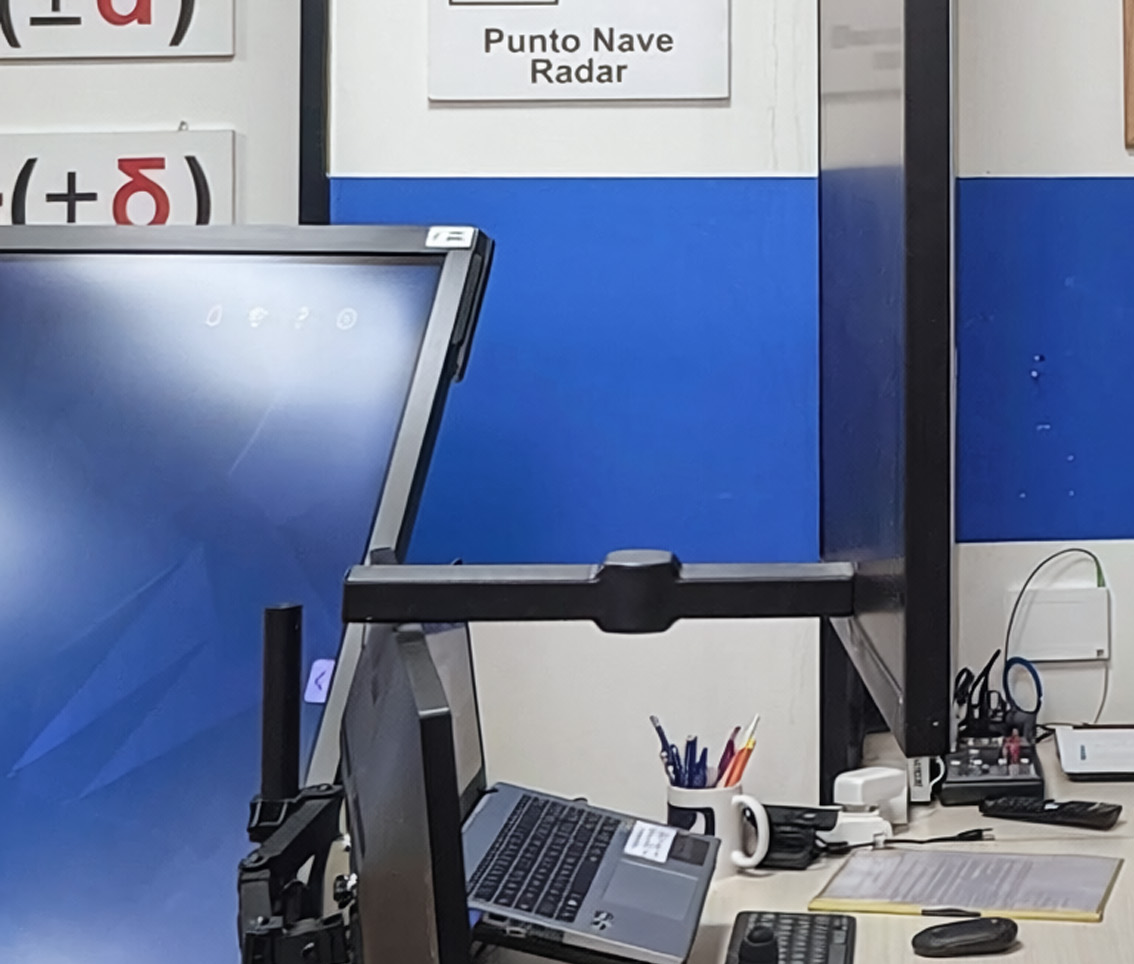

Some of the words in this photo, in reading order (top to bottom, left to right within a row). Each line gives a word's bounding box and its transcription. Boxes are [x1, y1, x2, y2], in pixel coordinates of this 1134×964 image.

[484, 28, 581, 53] Punto
[593, 27, 674, 53] Nave
[531, 57, 628, 84] Radar
